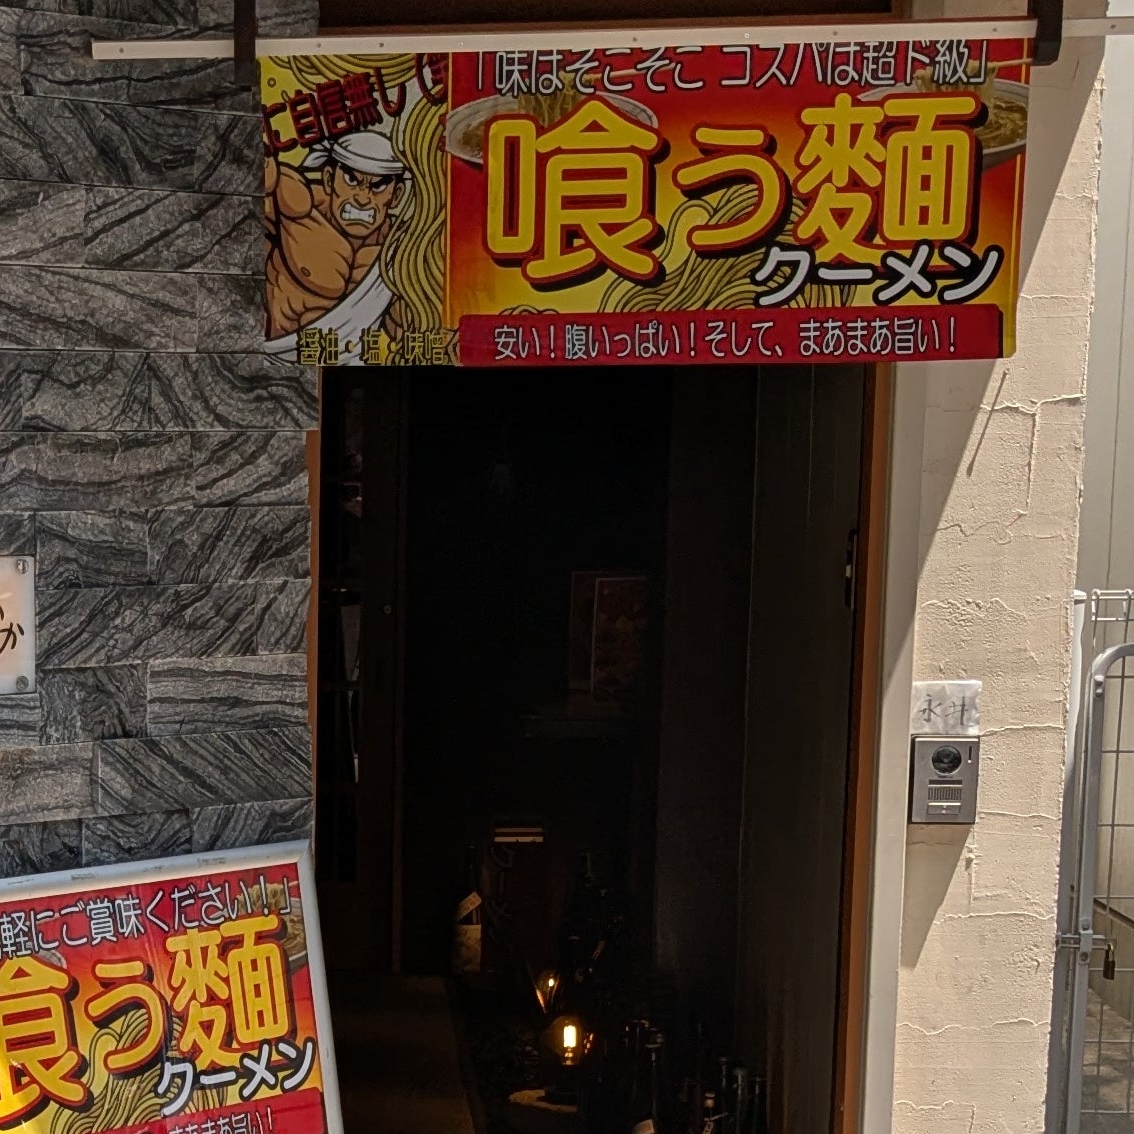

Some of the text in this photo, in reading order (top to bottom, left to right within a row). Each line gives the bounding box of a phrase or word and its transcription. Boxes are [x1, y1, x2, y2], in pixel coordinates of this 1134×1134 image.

[754, 243, 1002, 306] クーメン
[157, 1039, 314, 1117] クーメン
